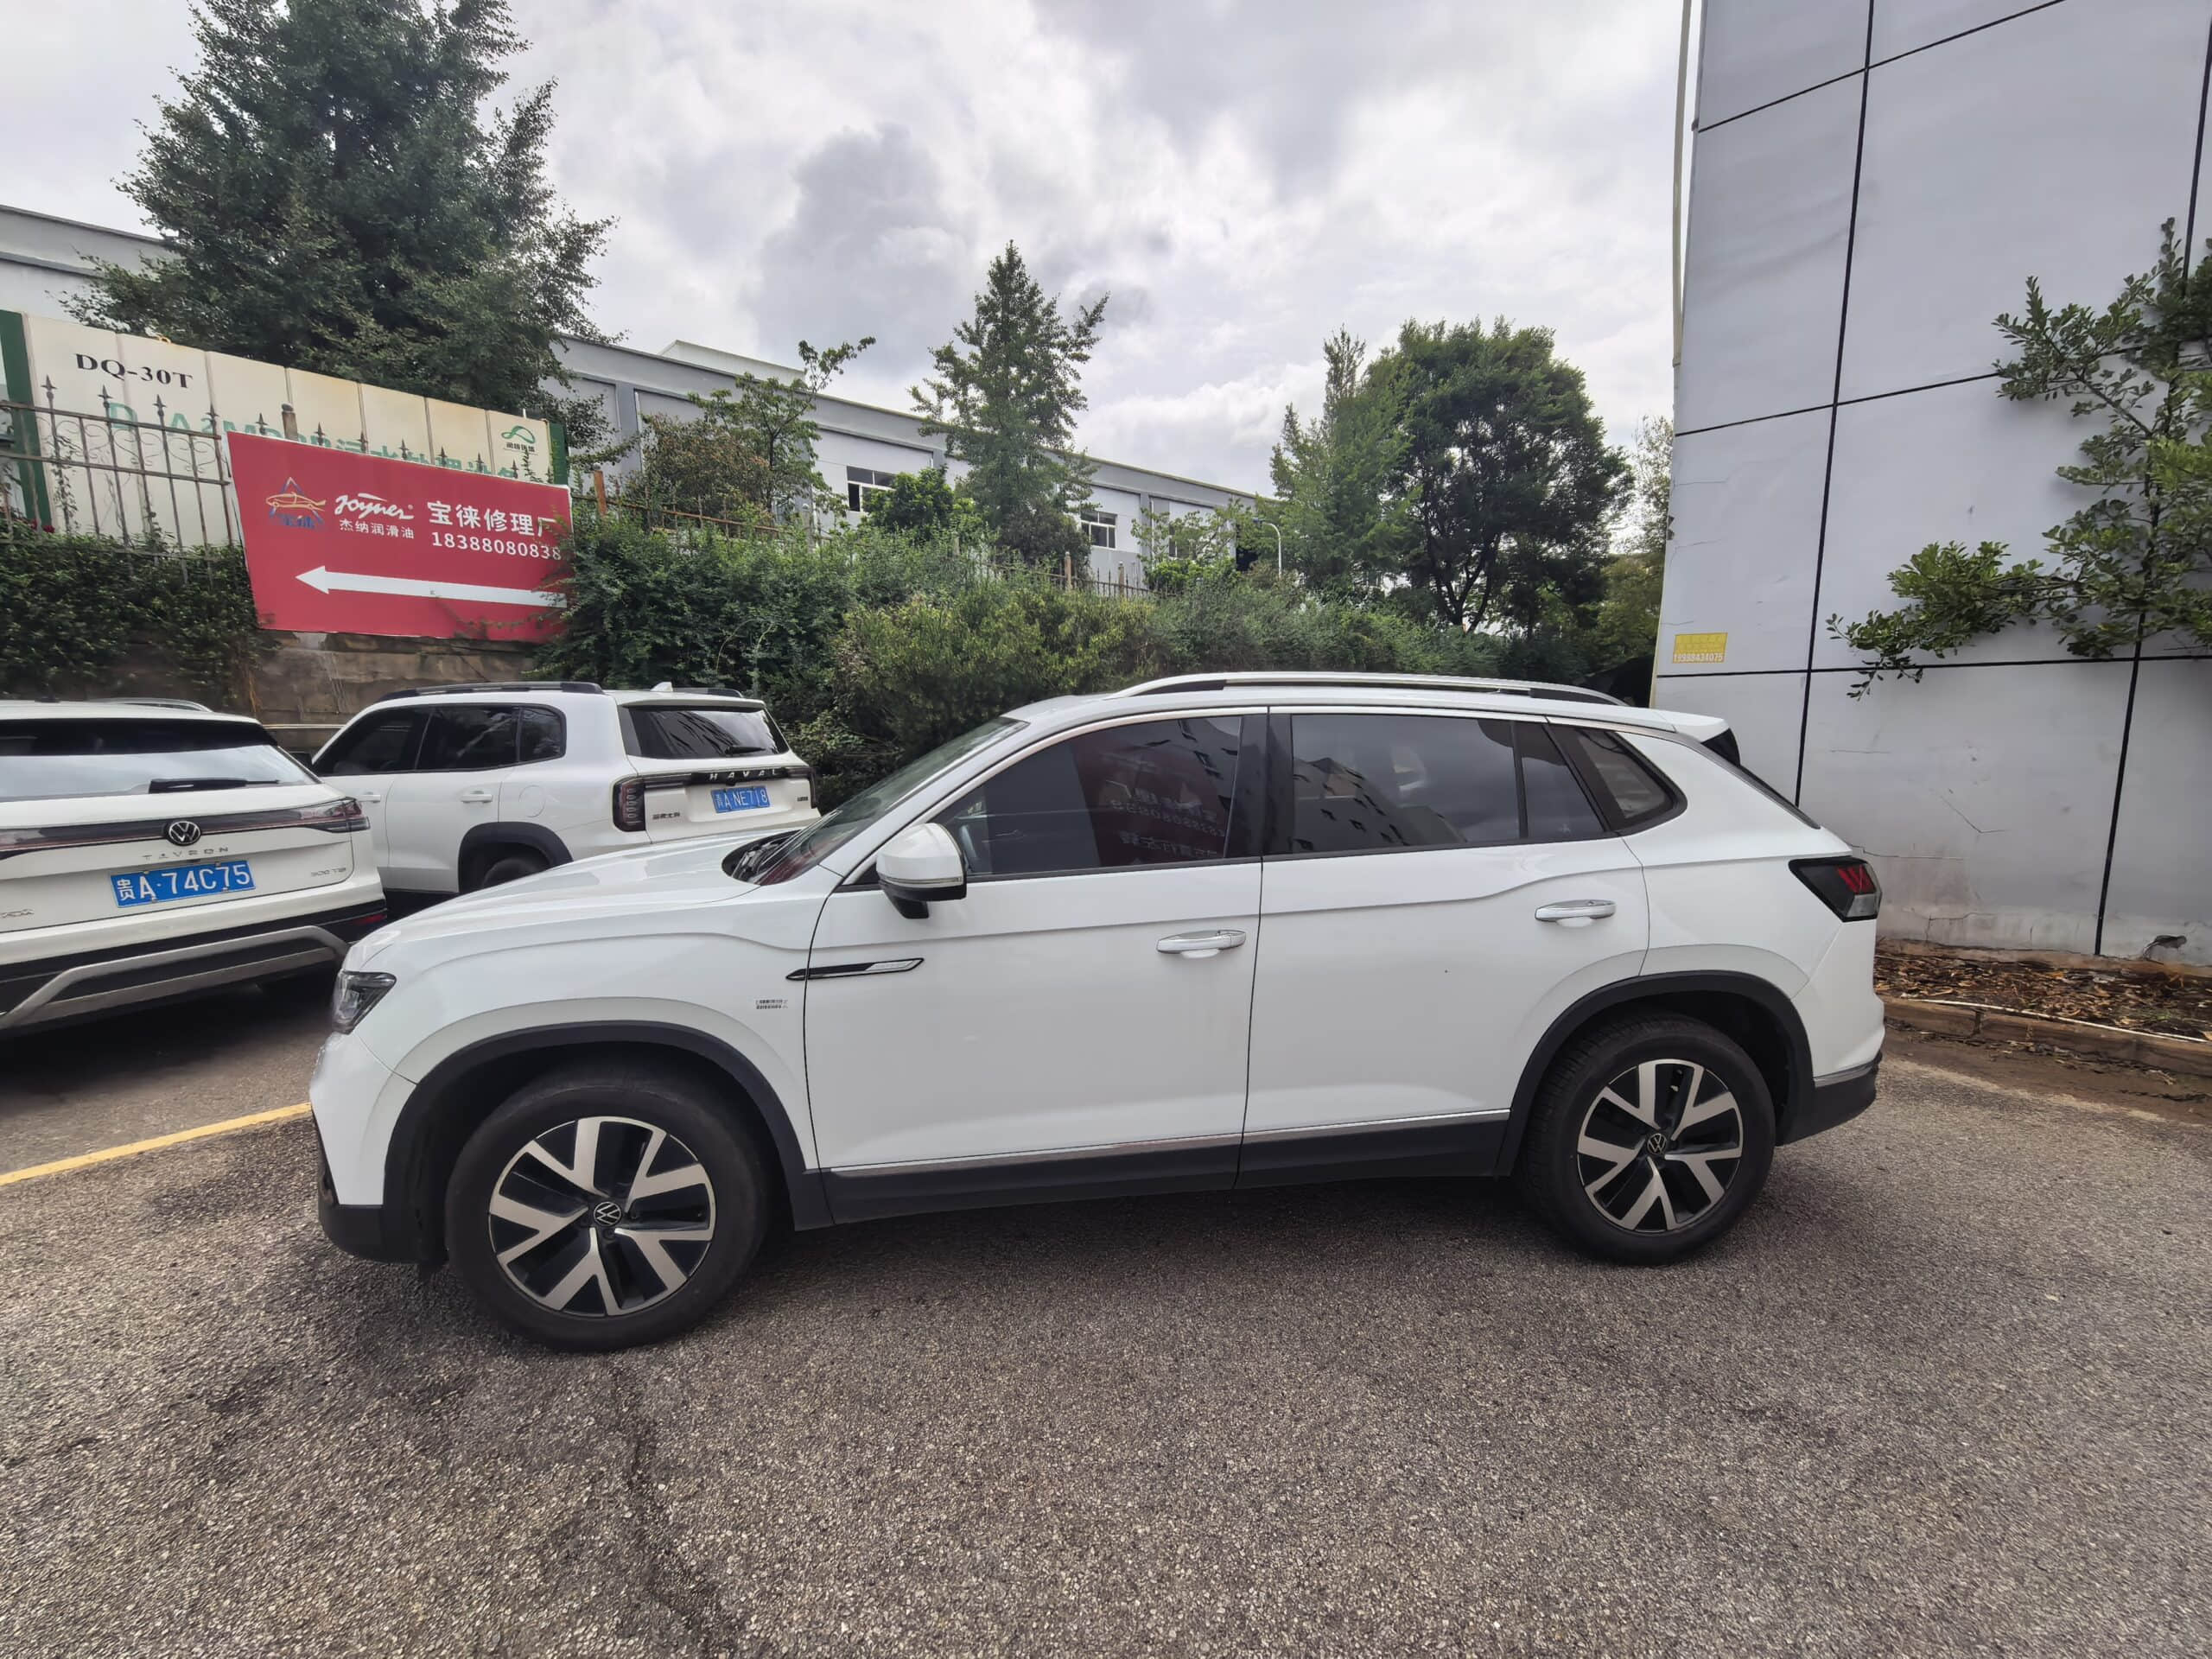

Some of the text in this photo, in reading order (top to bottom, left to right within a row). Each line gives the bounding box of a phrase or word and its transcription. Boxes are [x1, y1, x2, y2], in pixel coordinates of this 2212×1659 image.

[75, 353, 193, 389] DQ-30T
[339, 518, 415, 539] 杰纳润滑油
[431, 531, 562, 561] 18388080838
[709, 768, 778, 780] HAVAL
